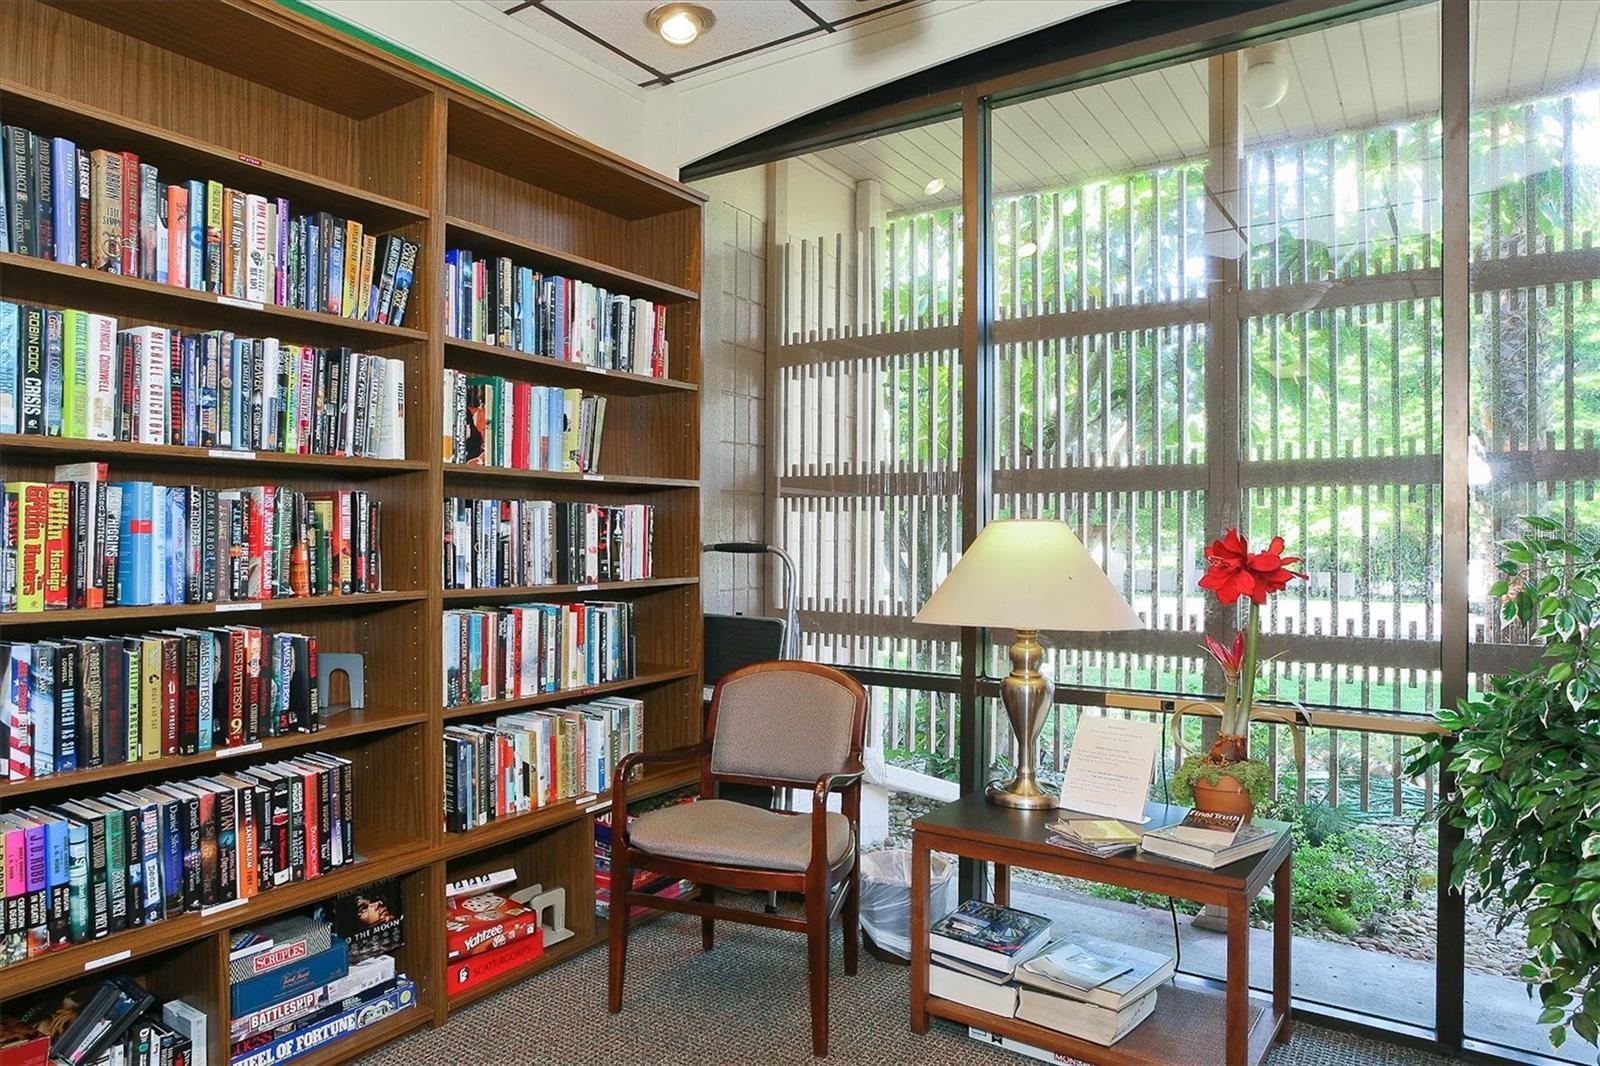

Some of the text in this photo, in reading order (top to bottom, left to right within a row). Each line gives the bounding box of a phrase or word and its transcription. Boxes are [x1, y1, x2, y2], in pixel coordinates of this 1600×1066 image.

[14, 131, 27, 191] DAVID BALDACCI
[40, 140, 51, 201] DAVID BALDACCI
[105, 156, 120, 200] DAN BROWN
[15, 203, 25, 243] COLLECTORS
[257, 201, 266, 251] TOM CLANCY
[28, 312, 40, 374] ROBIN COOK
[75, 313, 87, 386] PATRICIA CORNWELL
[98, 320, 112, 393] PATRICIA CORNWELL
[24, 377, 42, 415] CRISIS
[150, 332, 163, 436] MICHAEL CRICHTON
[254, 359, 264, 390] DEAVER
[357, 357, 367, 408] VINCE FLYNN
[26, 487, 46, 540] Griffin
[48, 488, 69, 540] Griffin
[97, 513, 105, 544] JUSTICE
[190, 491, 200, 545] KAY HOOPER
[206, 491, 215, 557] DARK HARBOR
[106, 518, 119, 557] HIGGINS
[46, 550, 65, 592] Hostage
[240, 542, 249, 582] FIRE ICE
[342, 558, 350, 582] GONE
[90, 652, 100, 678] ROBERT
[201, 639, 210, 720] JAMES PATTERSON
[233, 635, 244, 717] JAMES PATTERSON
[282, 642, 292, 710] JAMES PATTERSON
[61, 688, 74, 756] INNOCENT AS SIN
[129, 654, 138, 751] PHILLIP MARGOLIN
[220, 795, 234, 831] AMY TAN
[244, 789, 252, 815] ROBERT
[322, 805, 330, 832] WOODS
[344, 794, 352, 821] WOODS
[1189, 810, 1240, 821] Final Truth
[169, 804, 178, 855] Daniel Silva
[190, 801, 200, 851] Daniel Silva
[30, 835, 45, 884] J.D. ROBB
[17, 897, 25, 929] CREATION
[38, 890, 46, 925] SALVATION
[112, 870, 126, 918] BROKEN PREY
[9, 909, 17, 930] DEATH
[95, 913, 107, 930] PREY
[355, 929, 370, 941] THE
[373, 920, 400, 934] MOON
[464, 924, 503, 951] Yahtzee
[255, 943, 304, 970] SCRUPLES
[251, 994, 314, 1028] BATTLESHIP
[276, 1040, 294, 1059] OF
[295, 1013, 356, 1051] FORTUNE
